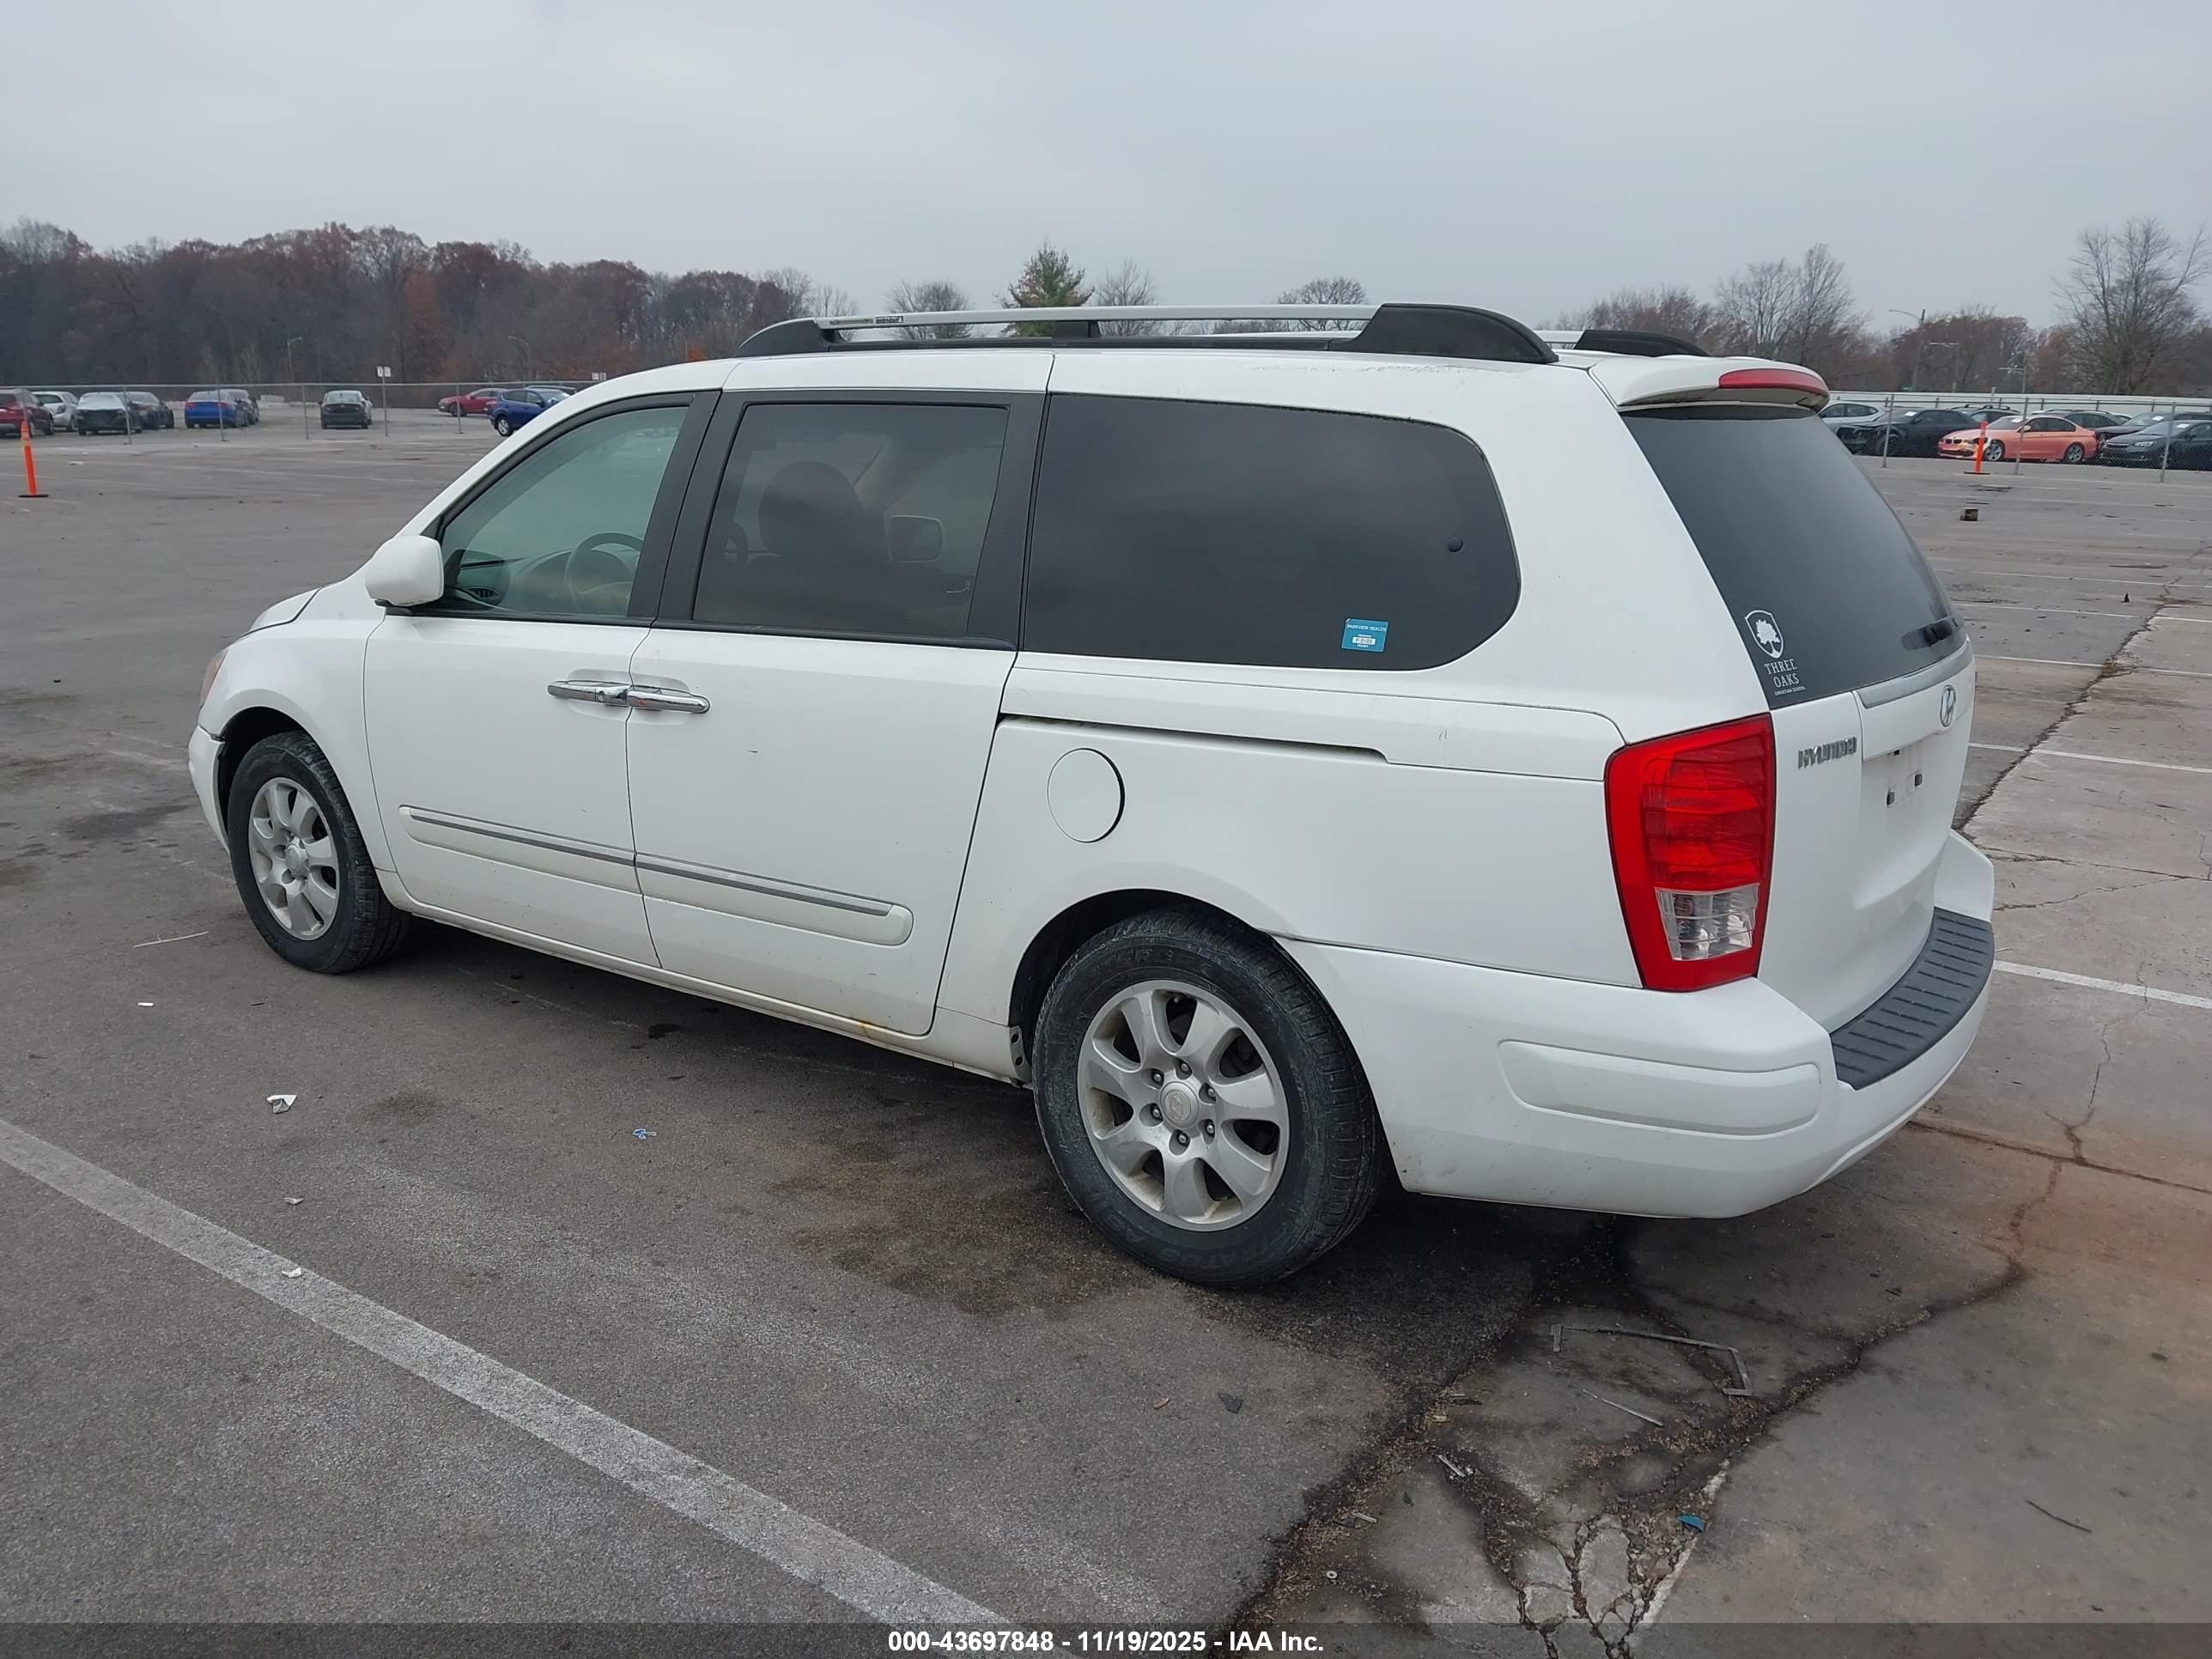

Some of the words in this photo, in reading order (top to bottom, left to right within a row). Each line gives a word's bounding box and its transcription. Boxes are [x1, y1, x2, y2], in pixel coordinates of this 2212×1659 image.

[1764, 659, 1798, 675] THREE
[1773, 673, 1800, 688] OAKS
[1798, 737, 1856, 769] HYUNDAI
